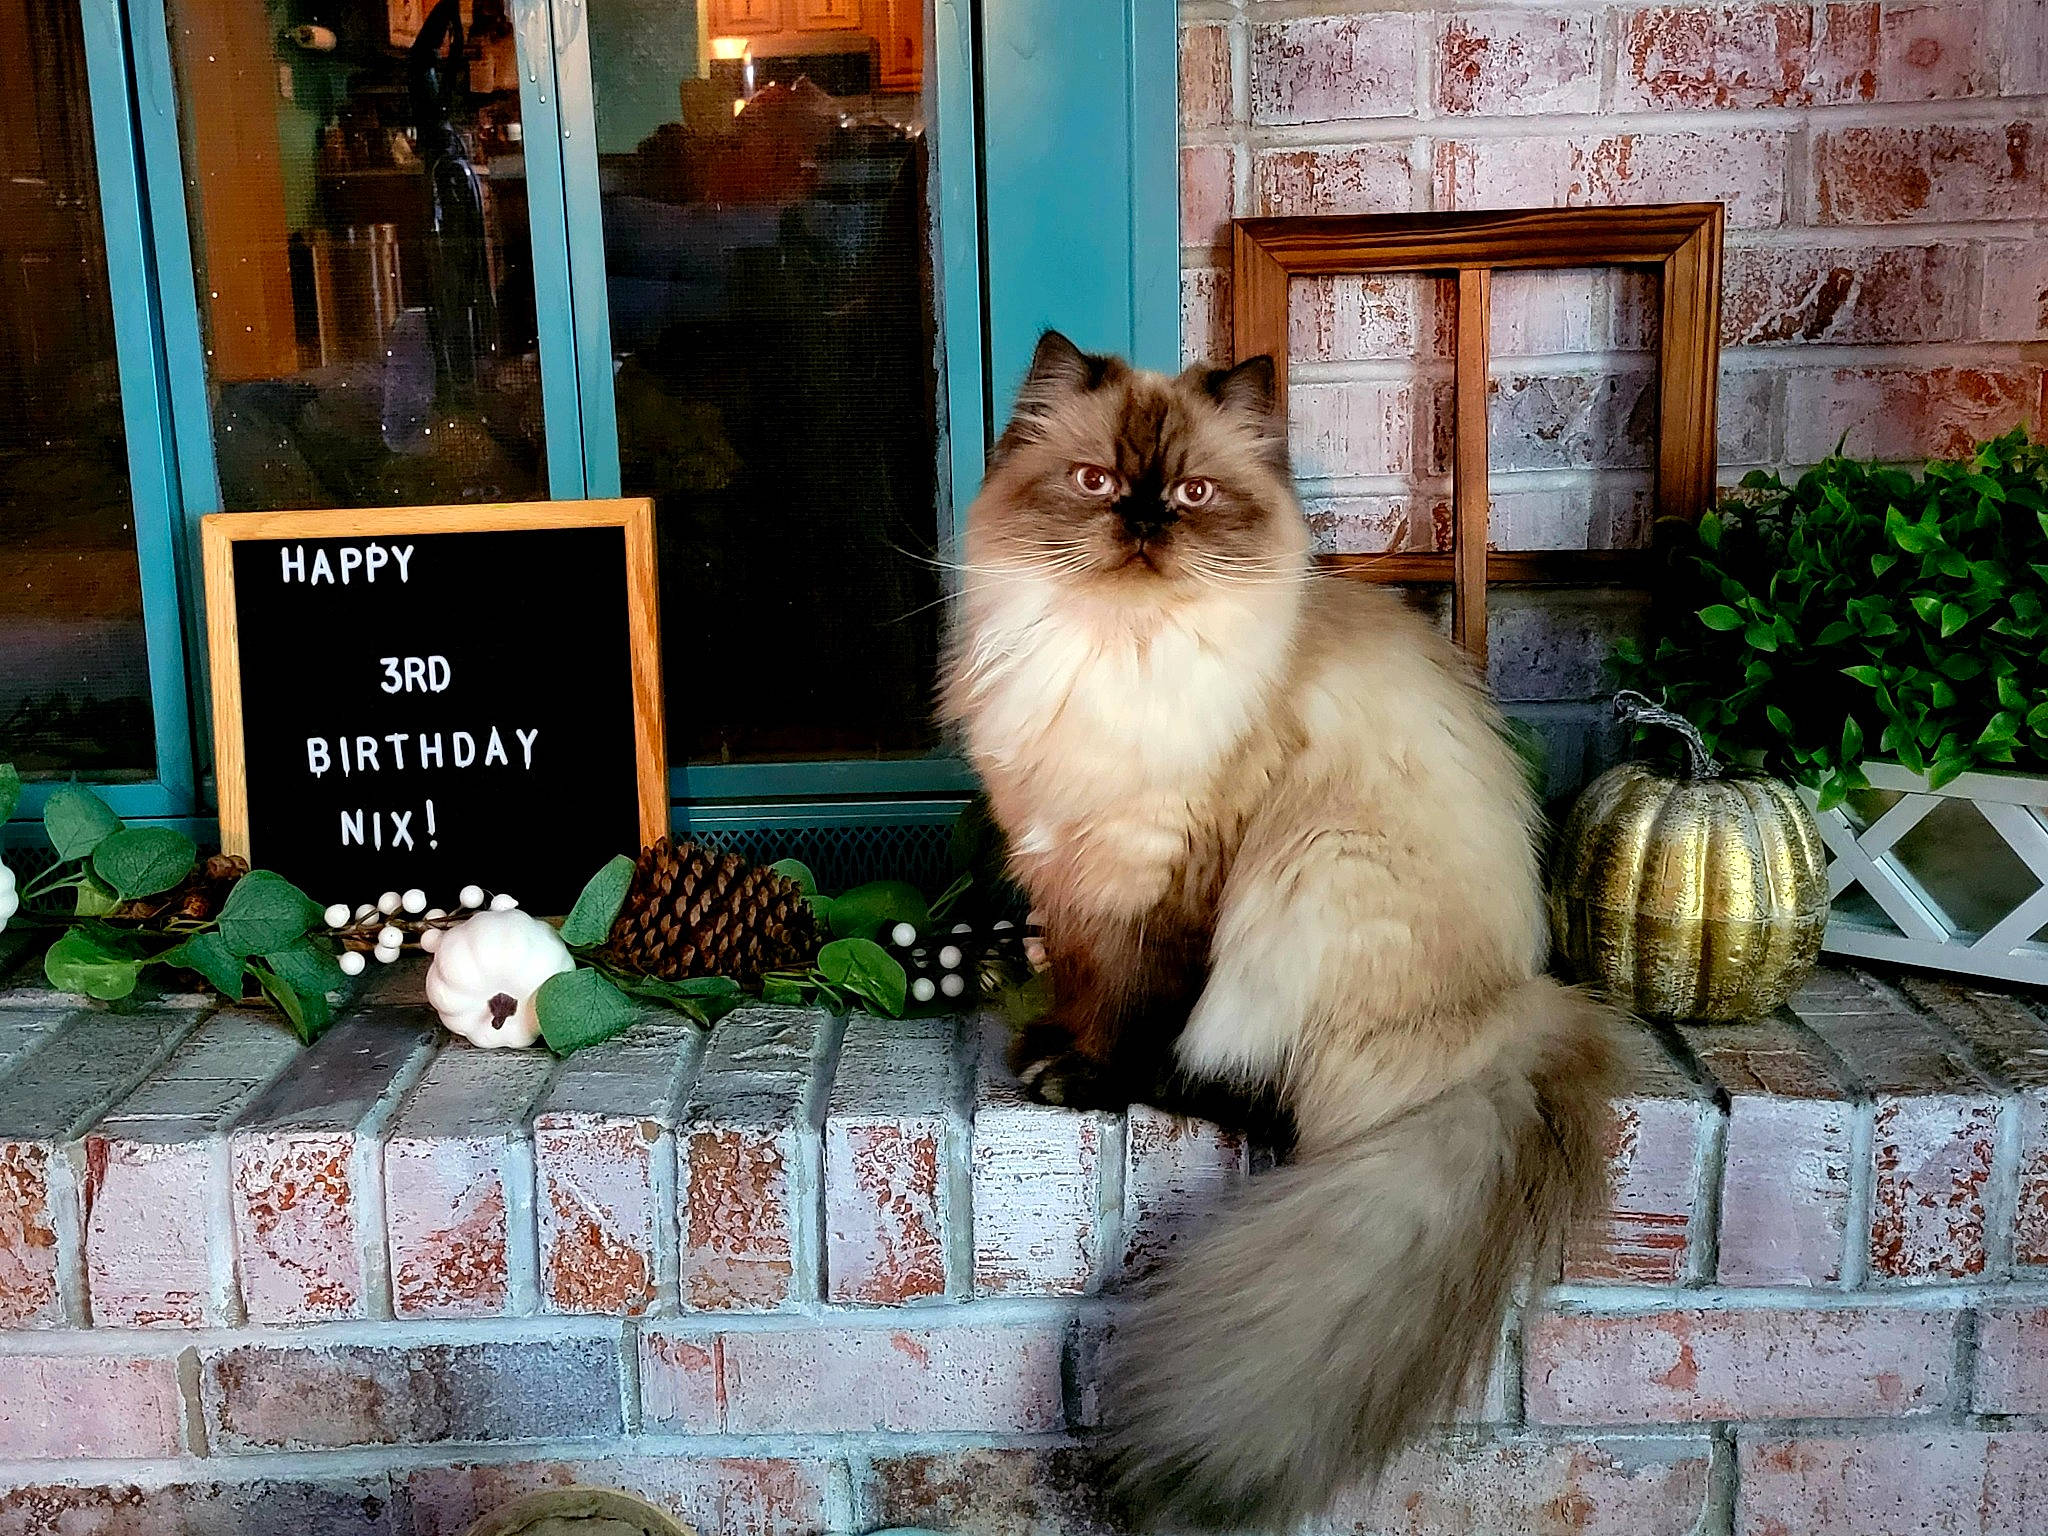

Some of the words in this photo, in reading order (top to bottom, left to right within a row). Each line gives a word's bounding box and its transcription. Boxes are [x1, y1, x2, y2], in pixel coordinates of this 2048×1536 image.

[280, 542, 415, 586] HAPPY
[379, 655, 451, 695] 3RD
[306, 726, 539, 778] BIRTHDAY
[340, 799, 438, 851] NIX!
